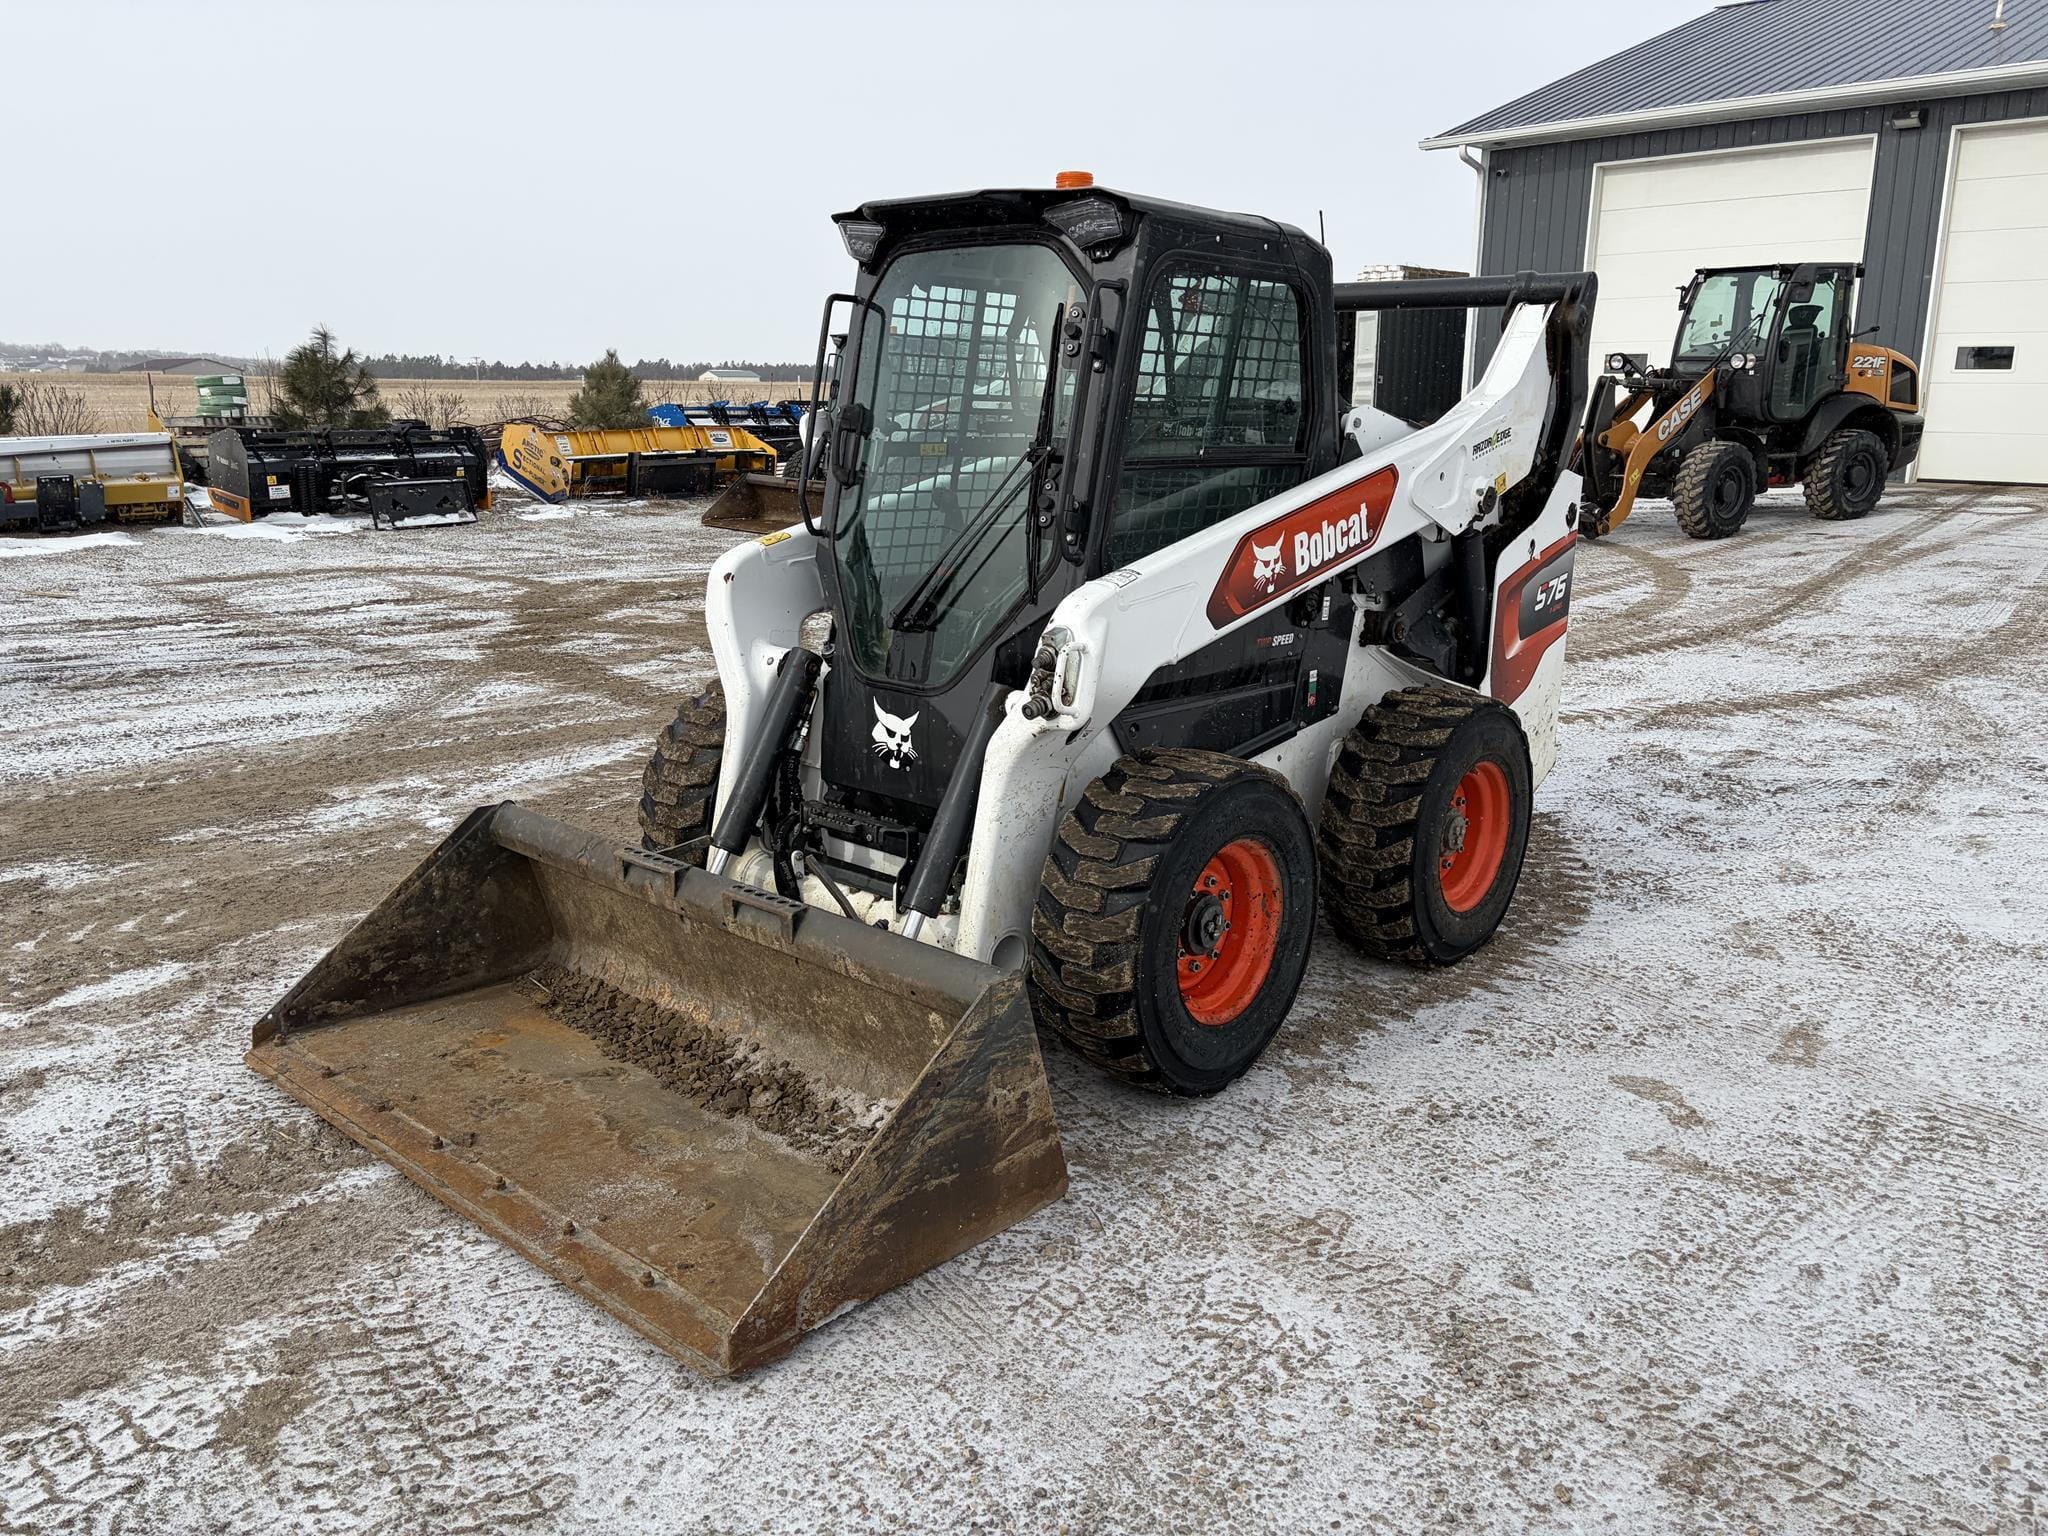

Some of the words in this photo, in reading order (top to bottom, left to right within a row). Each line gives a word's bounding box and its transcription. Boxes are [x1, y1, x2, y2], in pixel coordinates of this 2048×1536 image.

[1852, 356, 1886, 368] 221F
[1658, 386, 1701, 441] CASE
[1294, 502, 1369, 576] Bobcat
[1534, 572, 1569, 612] S76
[1271, 632, 1295, 647] SPEED
